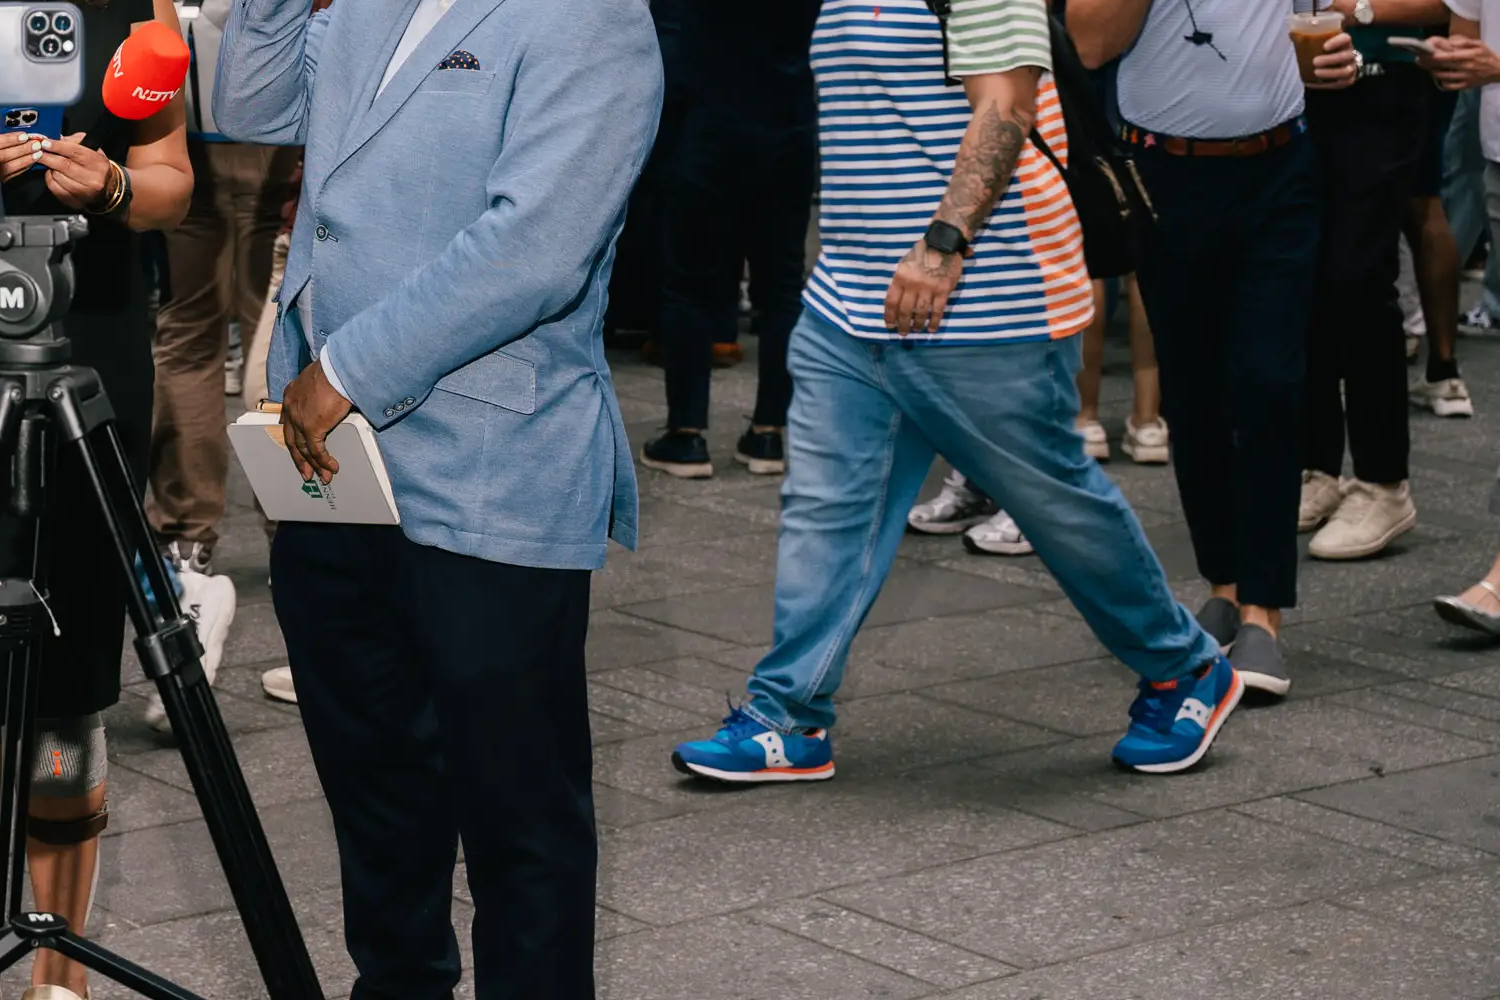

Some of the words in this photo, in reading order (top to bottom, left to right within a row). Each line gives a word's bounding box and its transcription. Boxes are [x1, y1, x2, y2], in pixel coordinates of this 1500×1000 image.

[131, 86, 181, 102] NDTV
[0, 286, 24, 309] M
[28, 913, 54, 922] M
